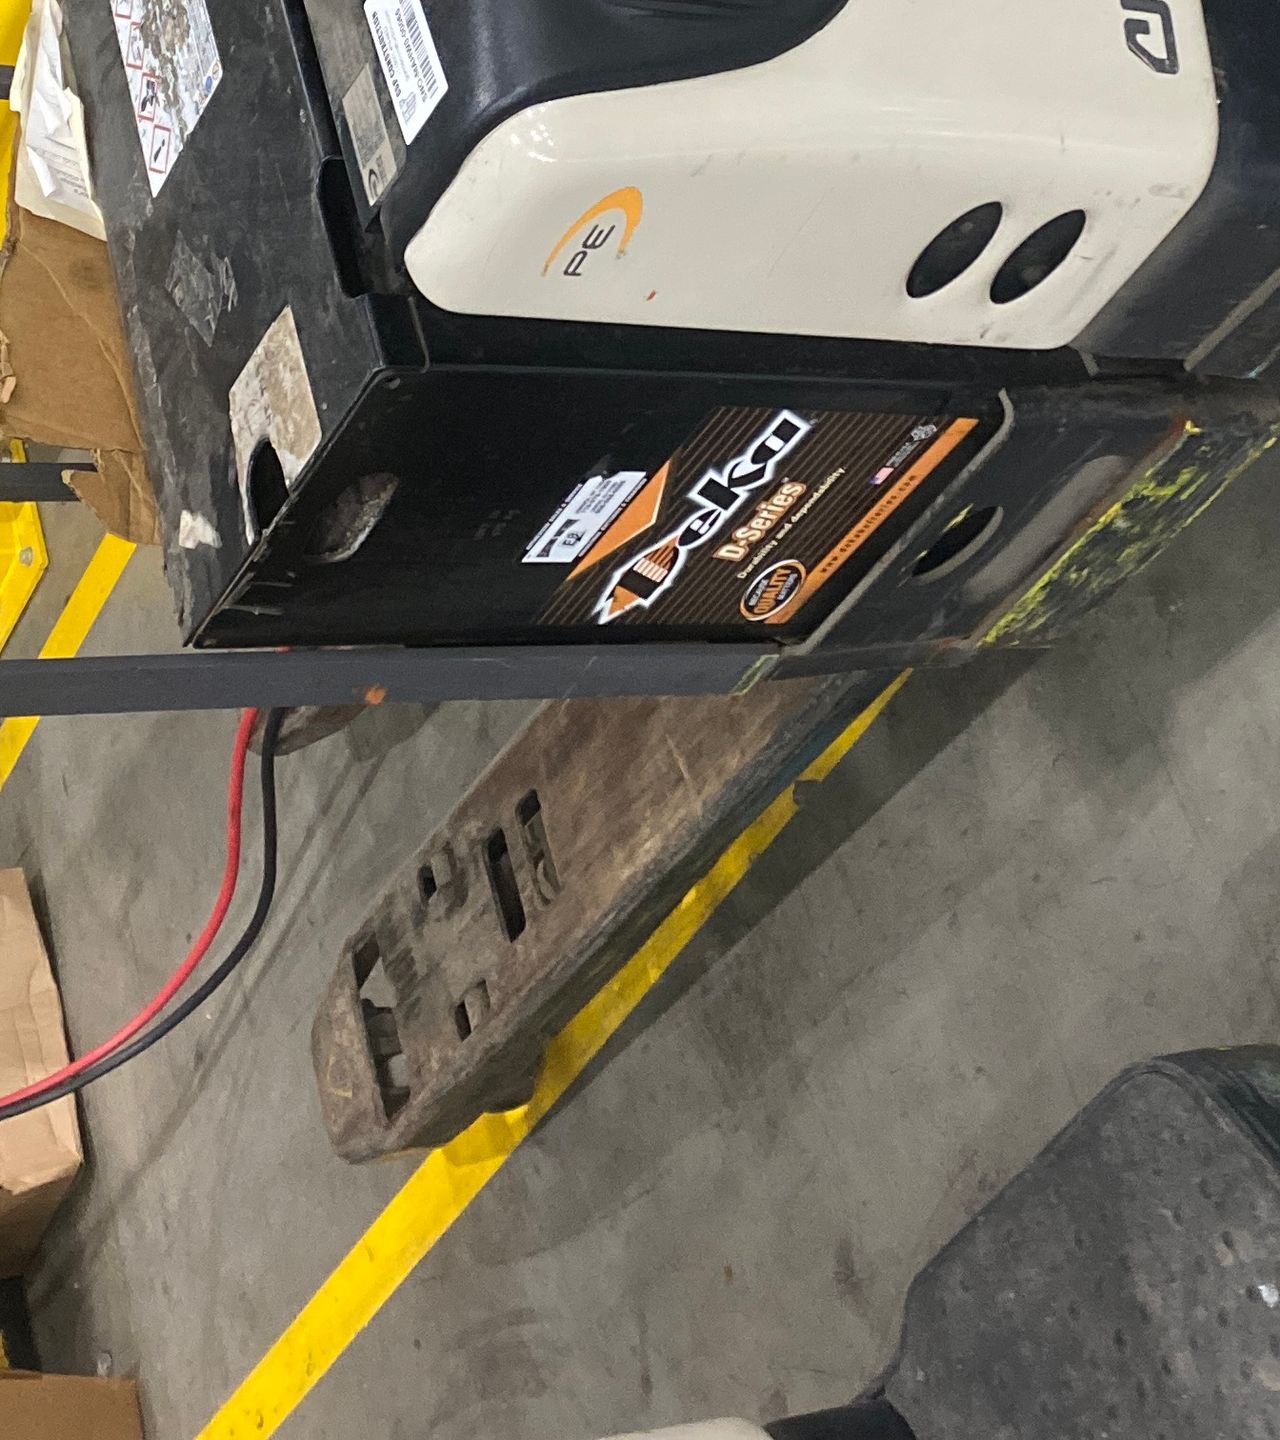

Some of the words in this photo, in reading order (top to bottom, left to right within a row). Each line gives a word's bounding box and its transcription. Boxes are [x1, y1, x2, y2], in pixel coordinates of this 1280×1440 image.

[562, 224, 616, 277] PE
[593, 409, 812, 625] Deka
[712, 481, 807, 561] D-Series
[736, 540, 779, 579] Durability
[775, 523, 793, 540] and
[753, 568, 791, 614] QUALITY
